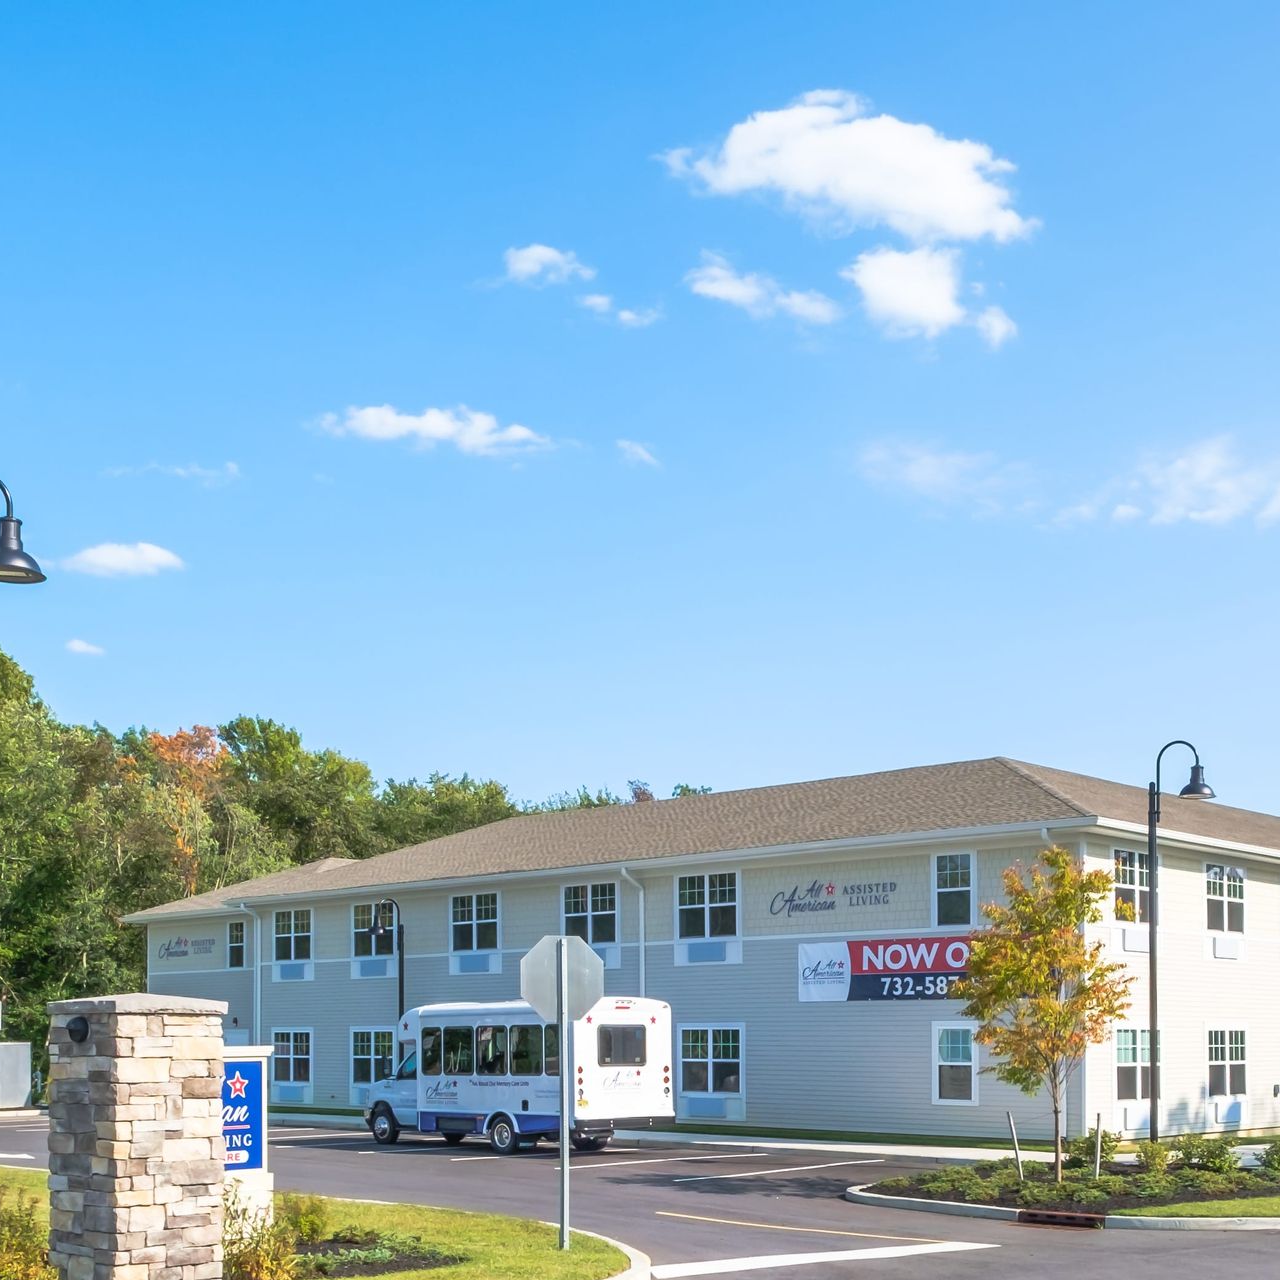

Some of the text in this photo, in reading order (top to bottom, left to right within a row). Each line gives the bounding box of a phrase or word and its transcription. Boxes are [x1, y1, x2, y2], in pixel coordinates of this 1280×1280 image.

[798, 880, 824, 900] All
[842, 882, 897, 895] ASSISTED
[770, 885, 836, 918] American
[849, 895, 889, 906] LIVING
[820, 960, 837, 970] All
[862, 941, 970, 970] NOW O
[802, 960, 844, 980] American
